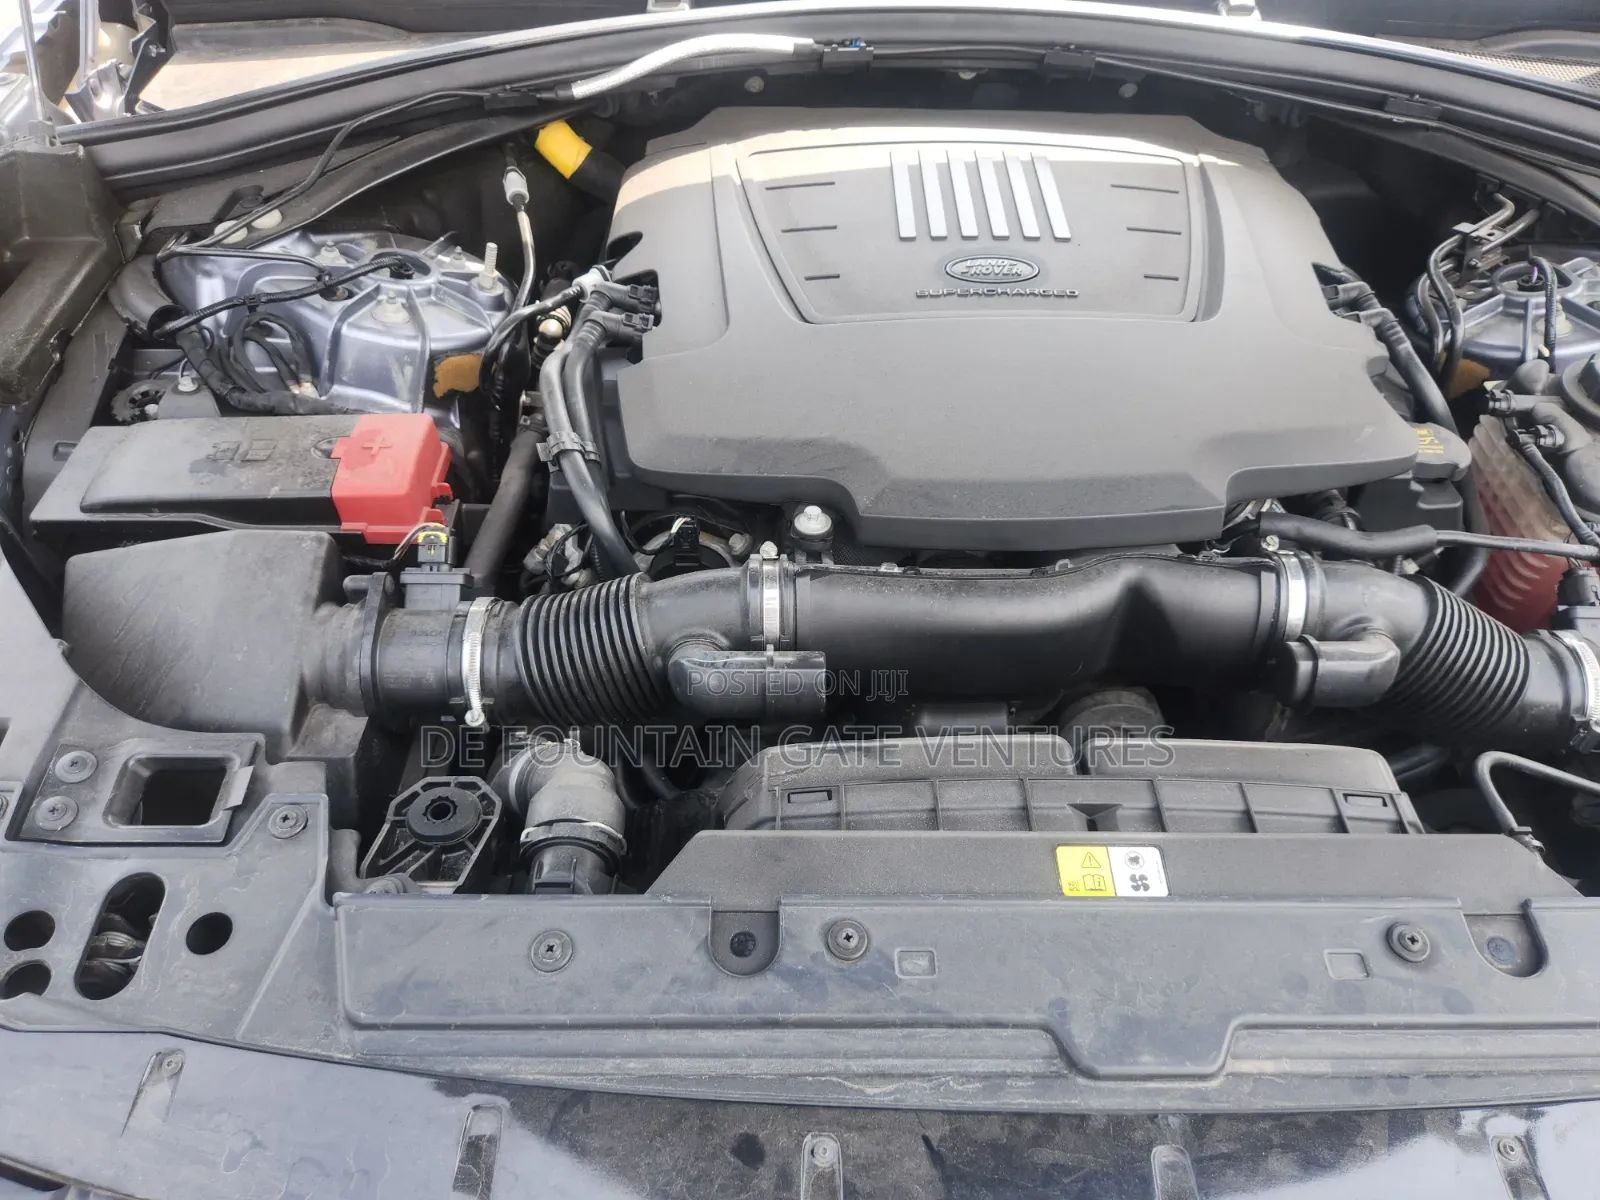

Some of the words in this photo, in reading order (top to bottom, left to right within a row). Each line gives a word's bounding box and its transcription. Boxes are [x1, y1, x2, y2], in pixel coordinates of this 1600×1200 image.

[965, 258, 1007, 268] LAND
[969, 265, 1023, 277] ROVER
[916, 288, 1079, 298] SUPERCHARGED
